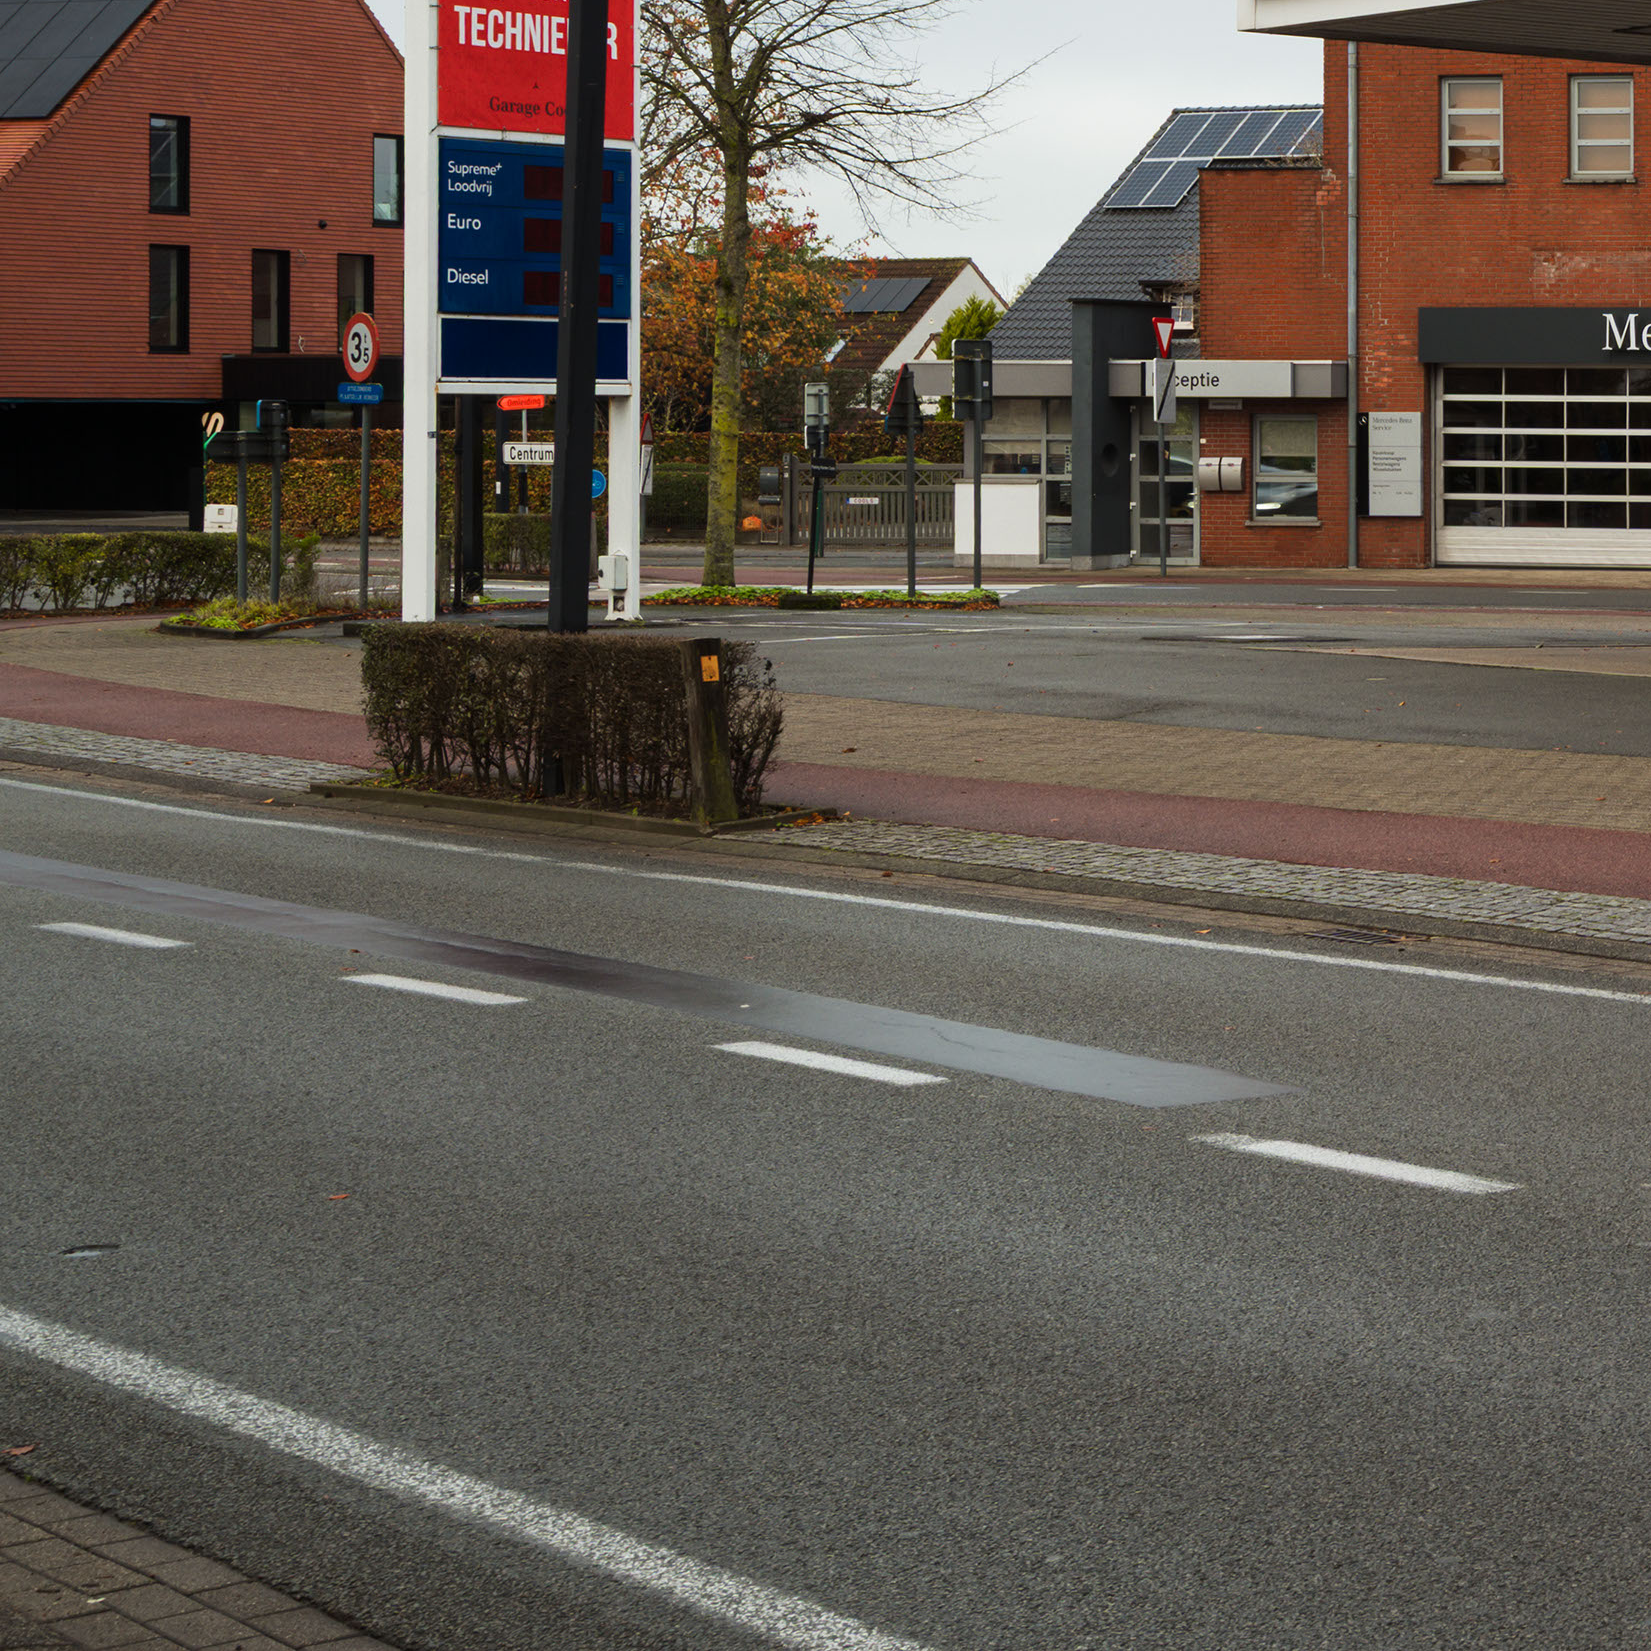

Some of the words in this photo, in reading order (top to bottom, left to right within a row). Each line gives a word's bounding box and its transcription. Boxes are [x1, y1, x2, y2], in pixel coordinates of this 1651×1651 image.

[453, 4, 618, 60] TECHNIER
[489, 96, 541, 118] Garage
[545, 101, 567, 117] Co
[448, 179, 492, 197] Loodvrij
[448, 213, 482, 230] Euro
[447, 268, 489, 285] Diesel
[1152, 372, 1220, 391] ceptie
[510, 446, 554, 461] Centrum
